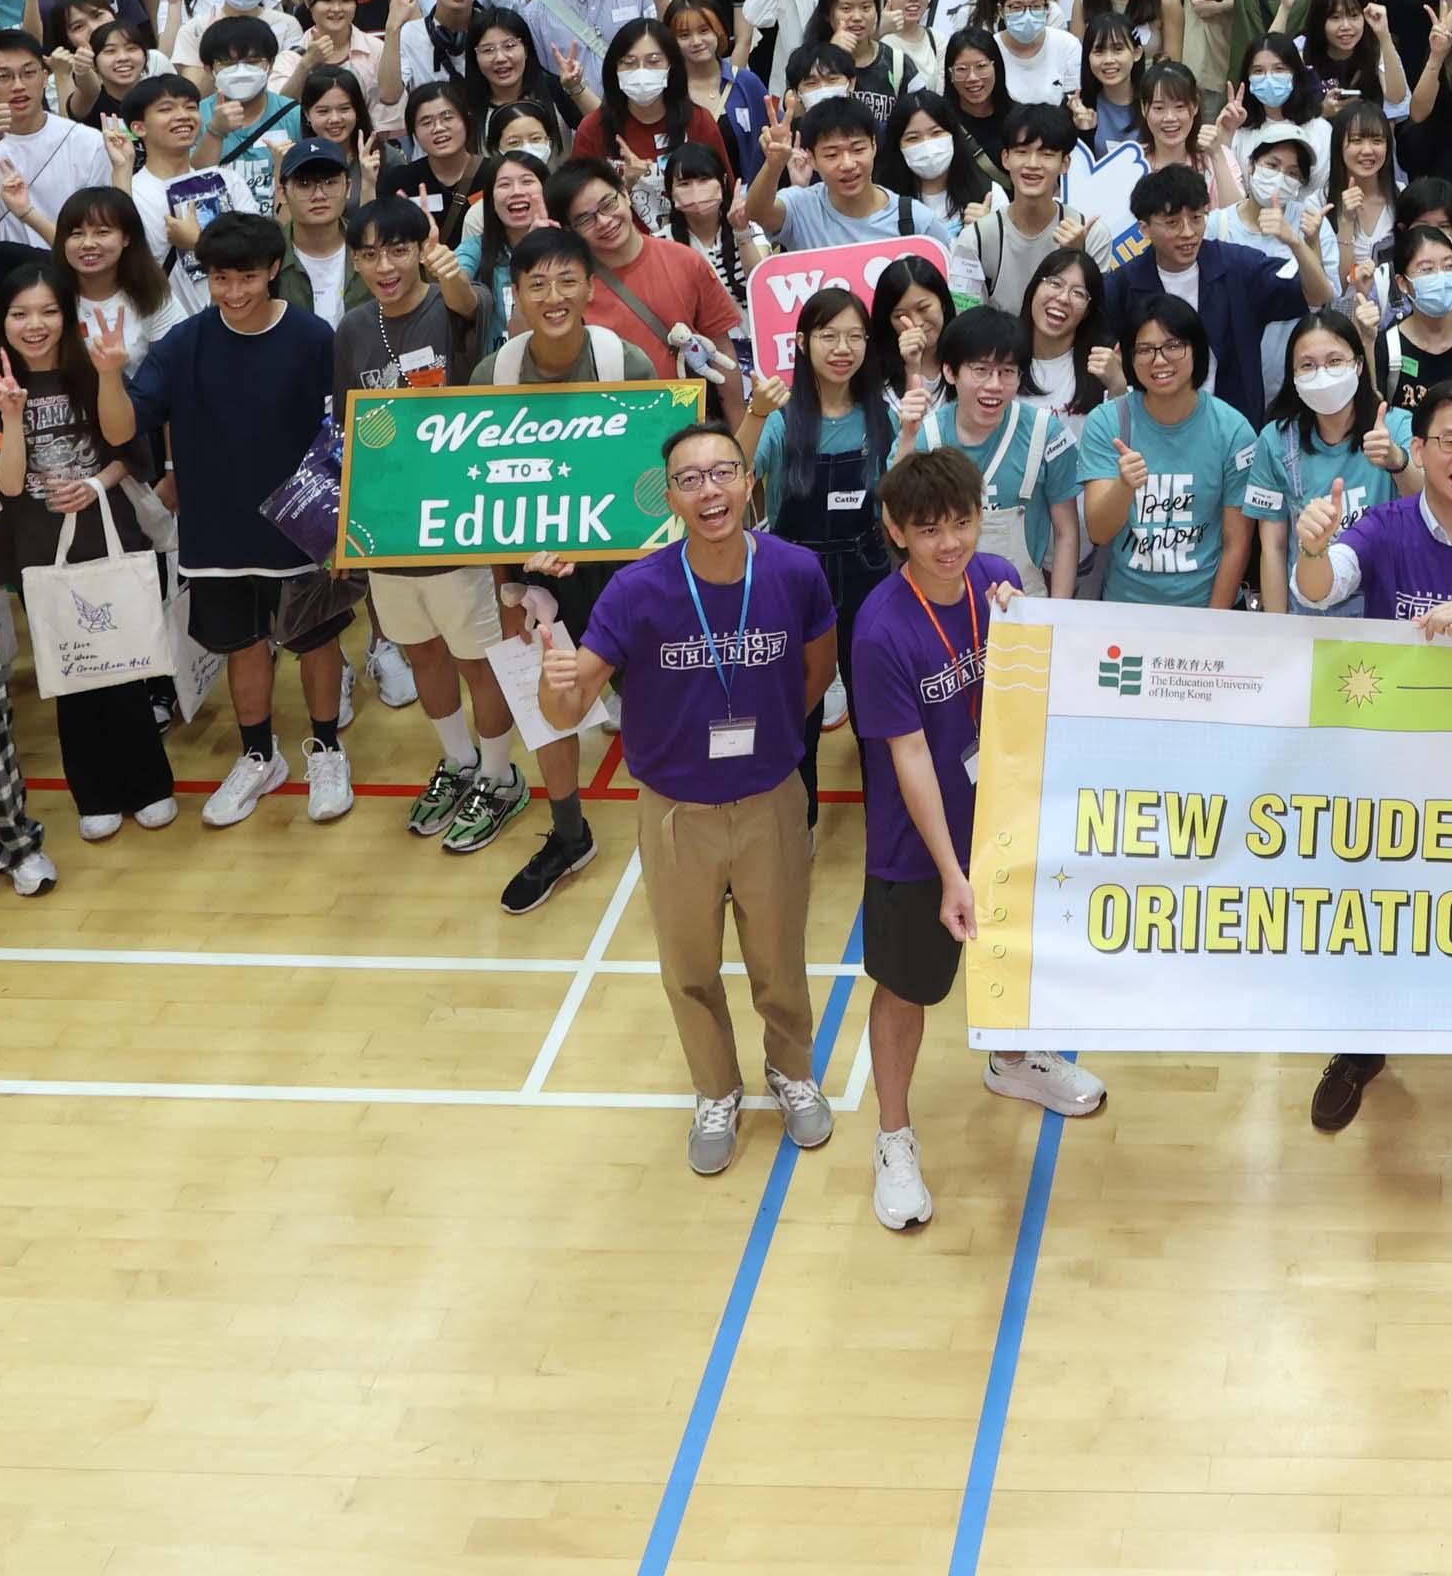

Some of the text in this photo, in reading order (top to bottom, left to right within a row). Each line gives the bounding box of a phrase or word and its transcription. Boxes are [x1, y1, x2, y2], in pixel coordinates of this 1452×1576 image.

[416, 407, 629, 455] Welcome
[510, 464, 532, 479] TO
[834, 494, 860, 506] Cathy
[1251, 496, 1274, 509] Kitty
[418, 493, 616, 547] EdUHK
[1128, 526, 1199, 573] ARE
[129, 656, 152, 668] Hall
[1152, 656, 1225, 672] 香港教育大學
[1150, 676, 1263, 693] The Education University
[1148, 688, 1212, 702] of Hong Kong
[1074, 788, 1224, 859] NEW
